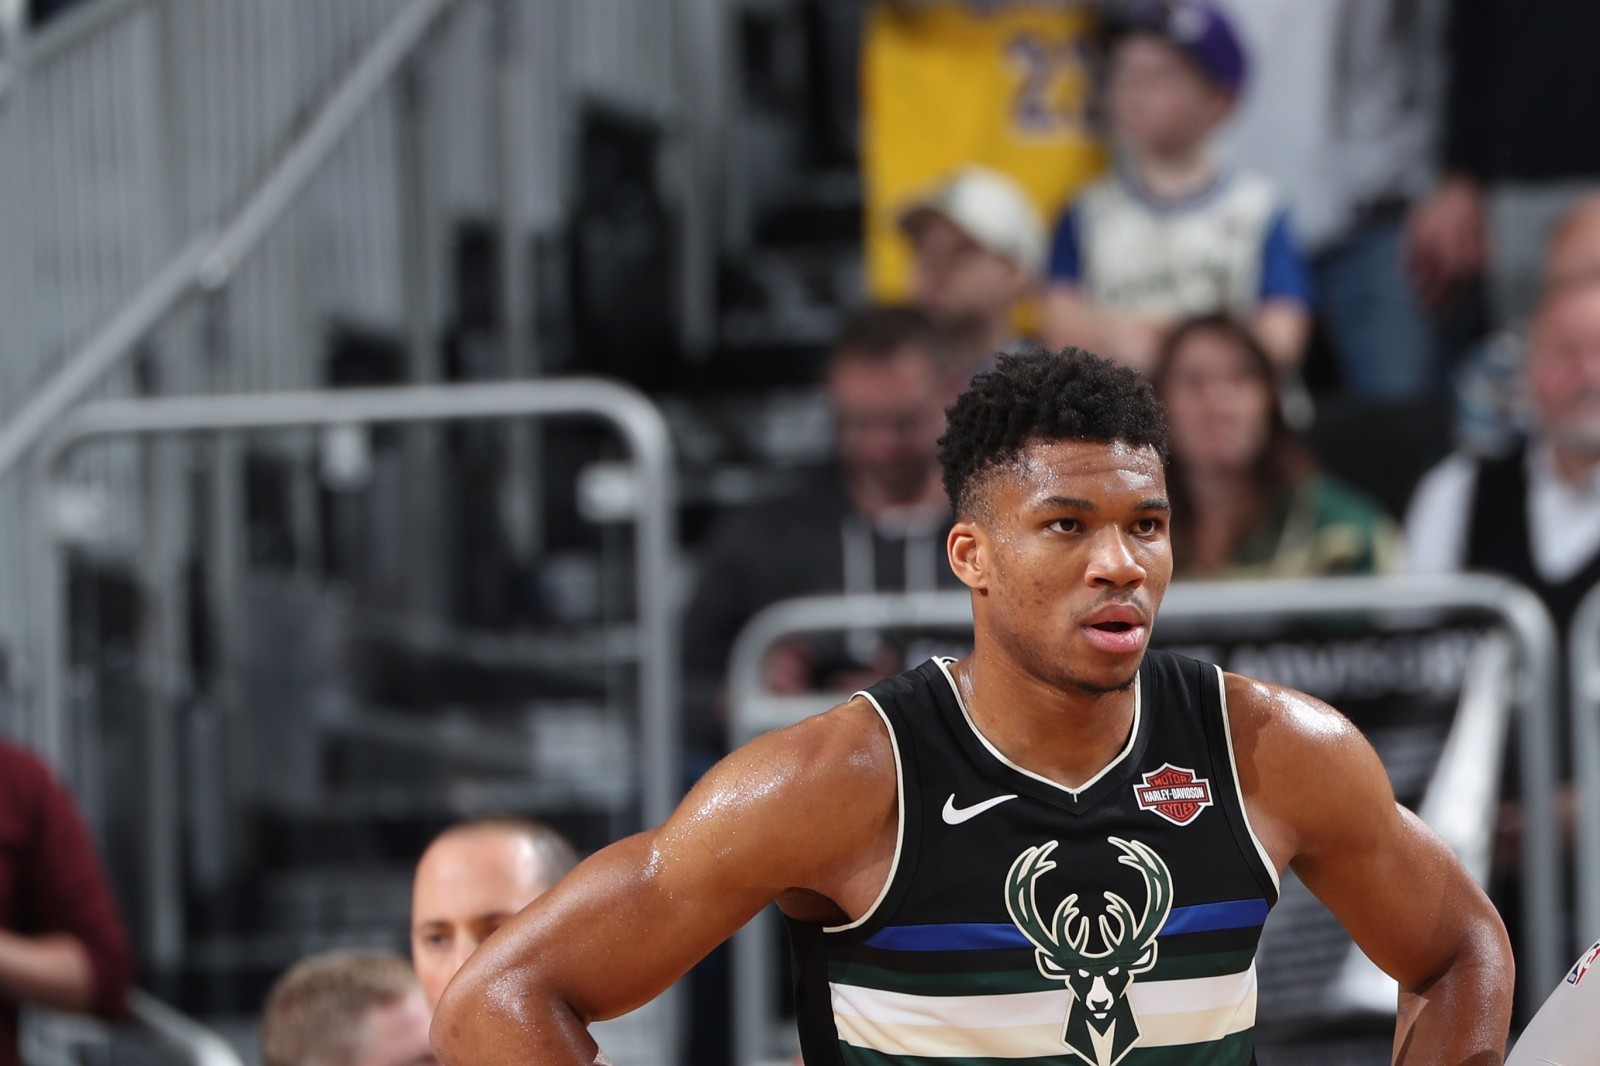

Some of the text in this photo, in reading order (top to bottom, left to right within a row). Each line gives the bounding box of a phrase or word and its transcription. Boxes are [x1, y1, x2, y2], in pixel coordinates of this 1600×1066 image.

[1153, 772, 1188, 786] MOTOR
[1142, 786, 1205, 803] HARLEY-DAVIDSON
[1162, 802, 1194, 818] CYCLES
